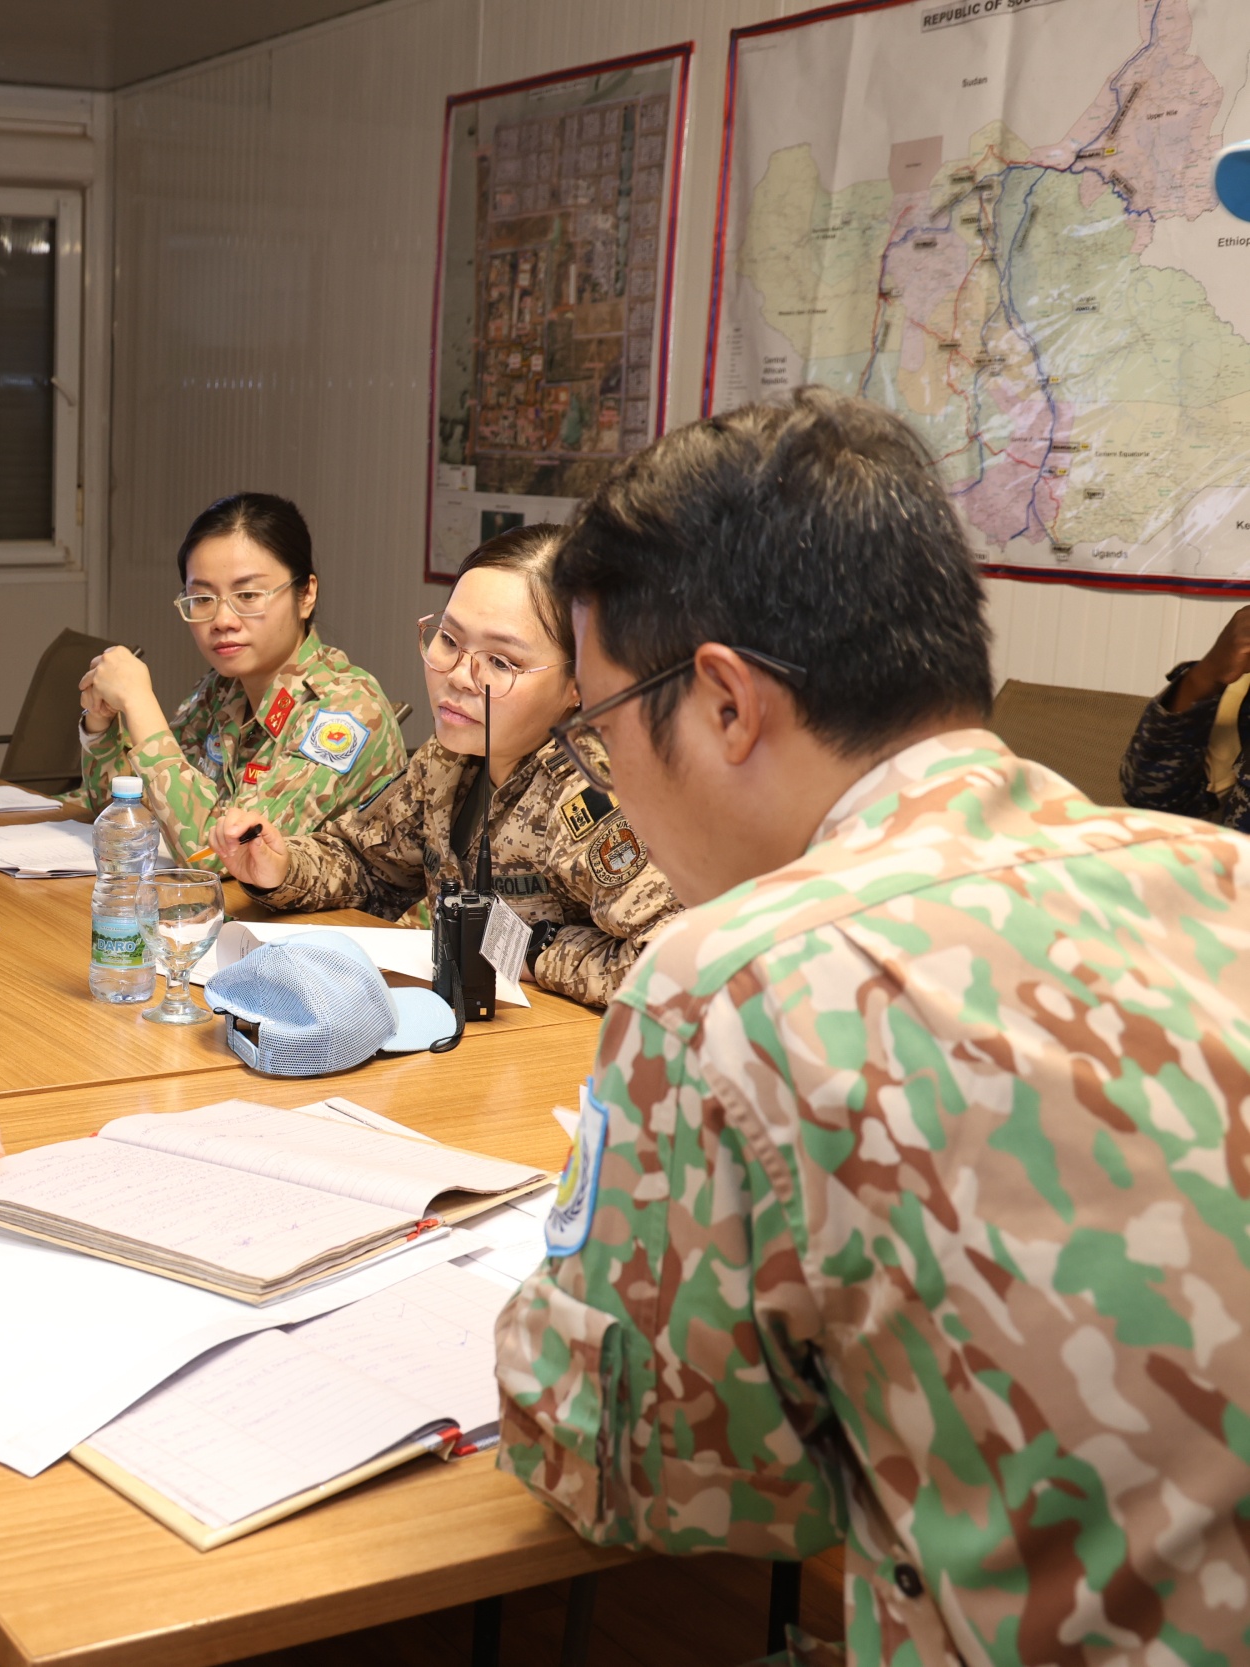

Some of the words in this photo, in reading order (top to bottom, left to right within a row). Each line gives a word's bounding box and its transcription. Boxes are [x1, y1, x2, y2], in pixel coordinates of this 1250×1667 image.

[923, 3, 981, 27] REPUBLIC
[984, 0, 1003, 12] OF
[962, 77, 988, 87] Sudan
[1092, 548, 1129, 560] Uganda
[491, 874, 545, 895] GOLIA
[97, 938, 137, 953] DARO
